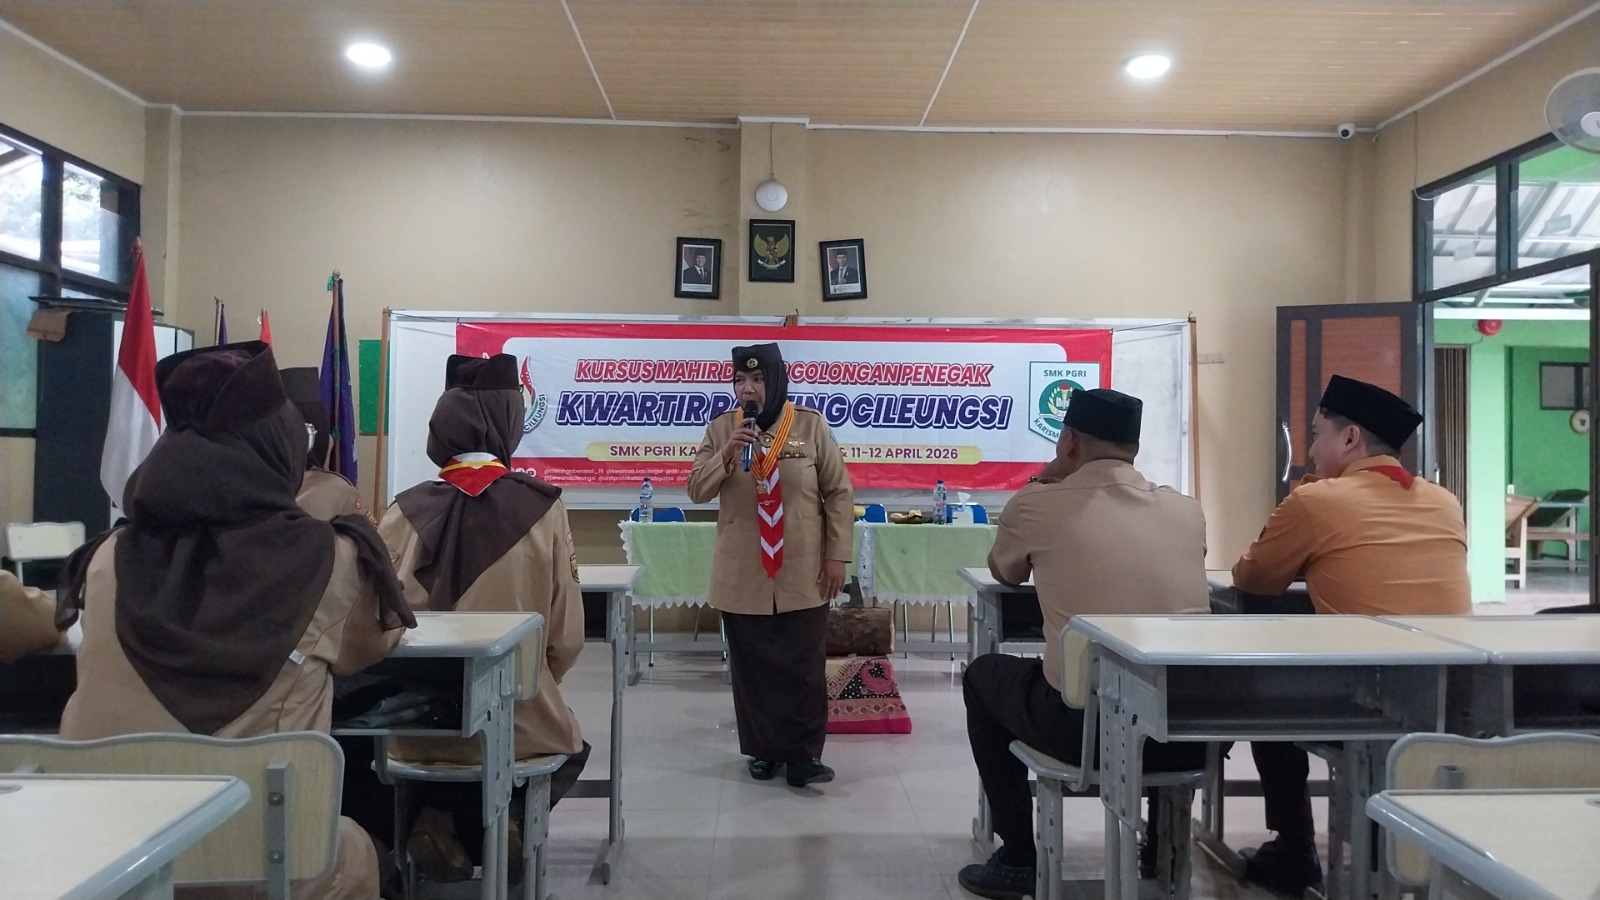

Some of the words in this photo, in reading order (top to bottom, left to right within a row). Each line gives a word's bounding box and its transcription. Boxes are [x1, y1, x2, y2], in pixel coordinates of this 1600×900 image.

[574, 359, 655, 383] KURSUS
[655, 360, 721, 383] MAHIR
[789, 361, 900, 385] GOLONGAN
[898, 363, 994, 386] PENEGAK
[1066, 370, 1087, 378] PGRI
[523, 393, 546, 431] CILEUNGSI
[556, 391, 710, 426] KWARTIR
[849, 394, 1013, 430] CILEUNGSI
[1033, 418, 1060, 439] KARISM
[610, 446, 640, 456] SMK
[644, 446, 676, 456] PGRI
[885, 448, 923, 459] APRIL
[925, 449, 958, 459] 2026
